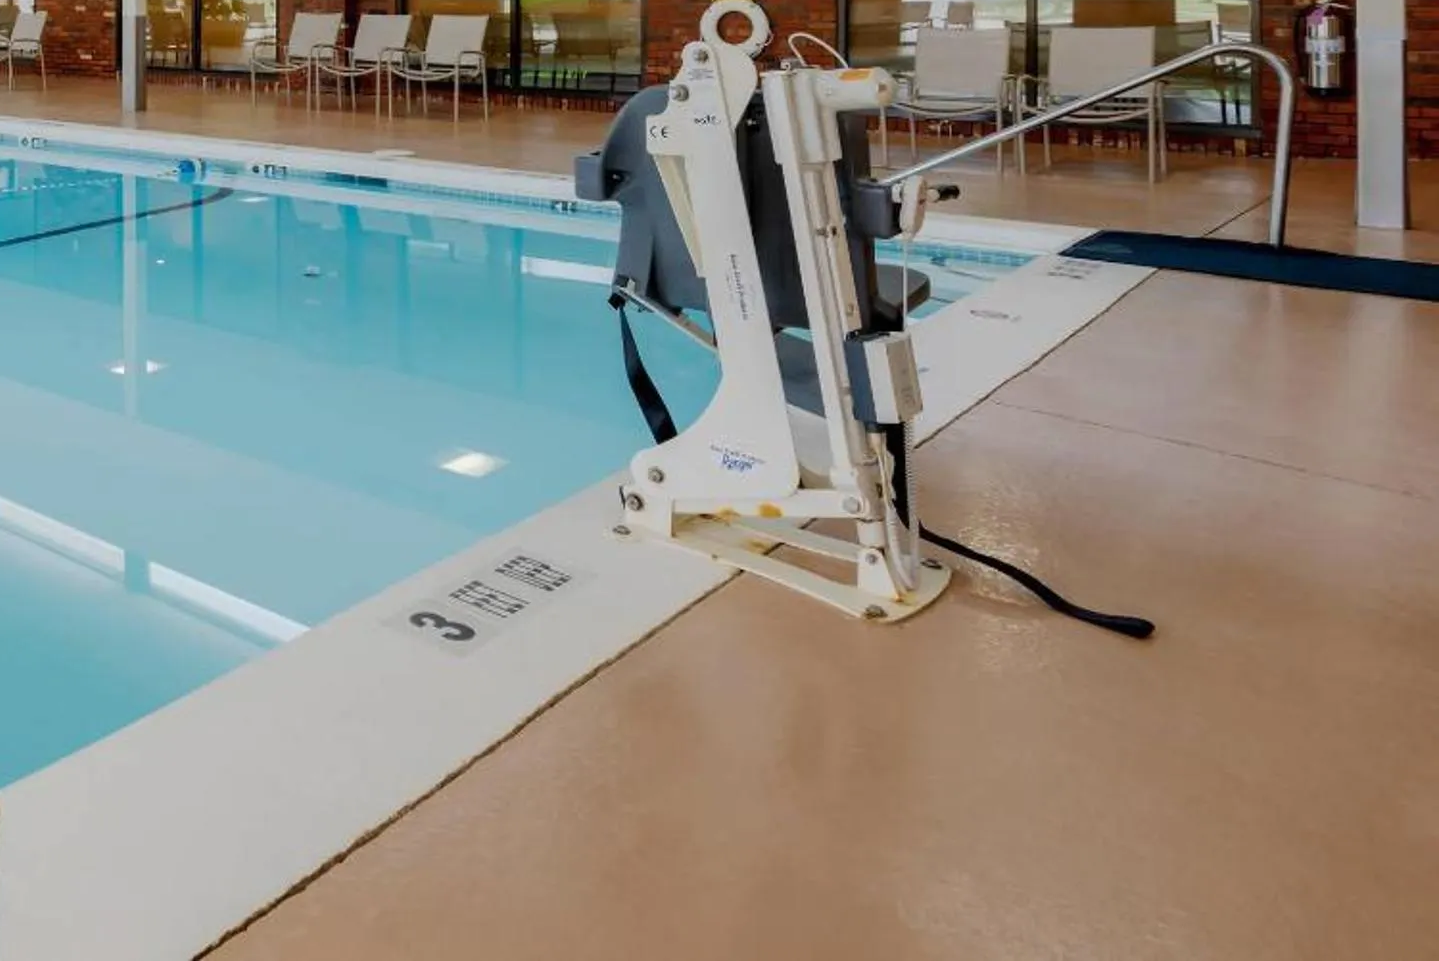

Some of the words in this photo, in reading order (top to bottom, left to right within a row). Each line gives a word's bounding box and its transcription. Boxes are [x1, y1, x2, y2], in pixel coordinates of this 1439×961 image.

[410, 612, 475, 641] 3
[448, 581, 531, 618] FEET
[494, 555, 572, 591] DEEP
